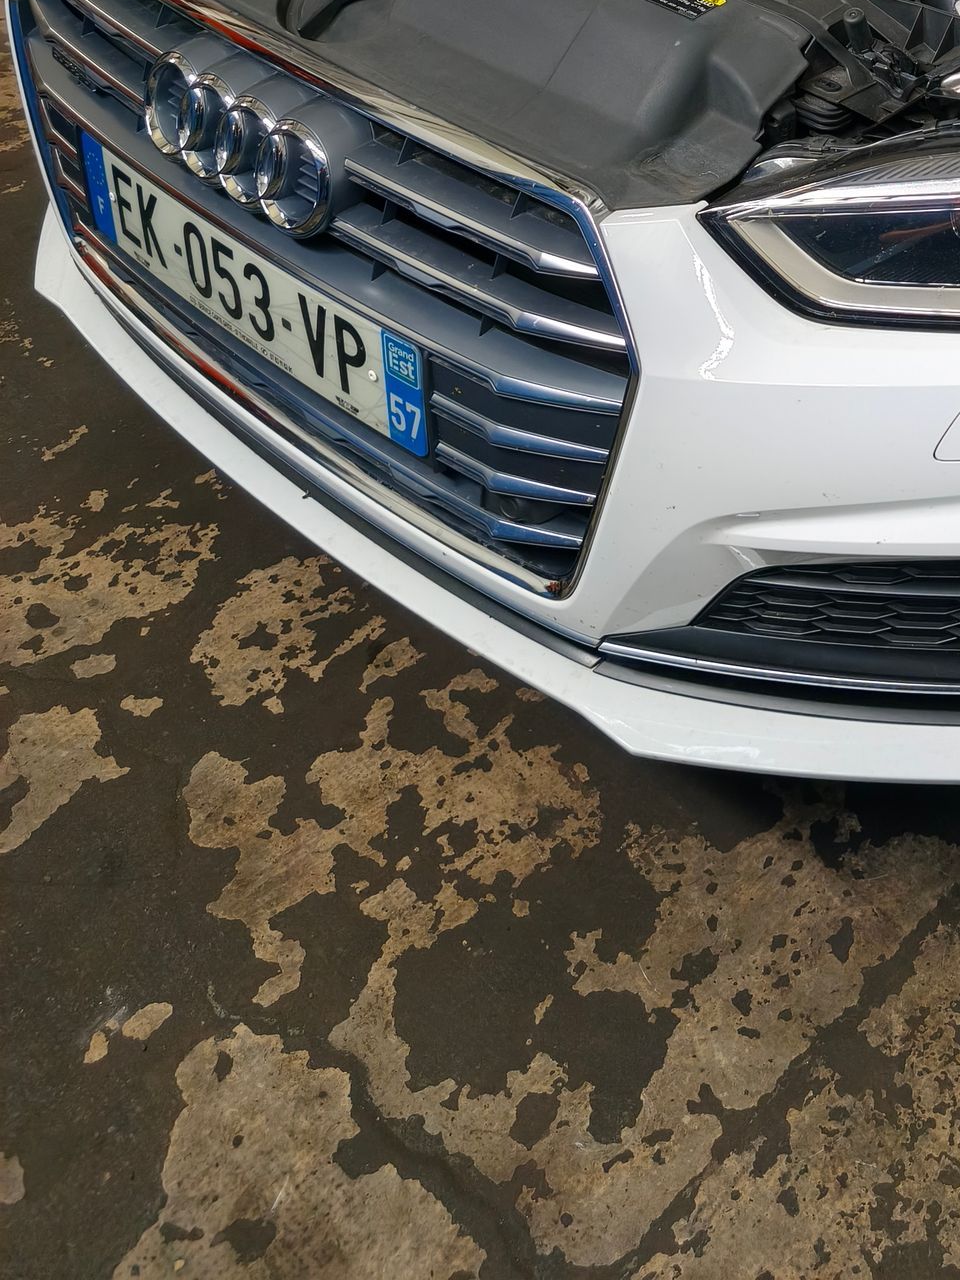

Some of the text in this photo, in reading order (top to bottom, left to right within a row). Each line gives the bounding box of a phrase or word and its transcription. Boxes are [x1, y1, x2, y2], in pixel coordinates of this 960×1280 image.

[97, 194, 105, 215] F
[111, 163, 367, 395] EK-053-VP
[388, 342, 414, 363] Grand
[389, 351, 415, 380] Est
[390, 392, 421, 440] 57
